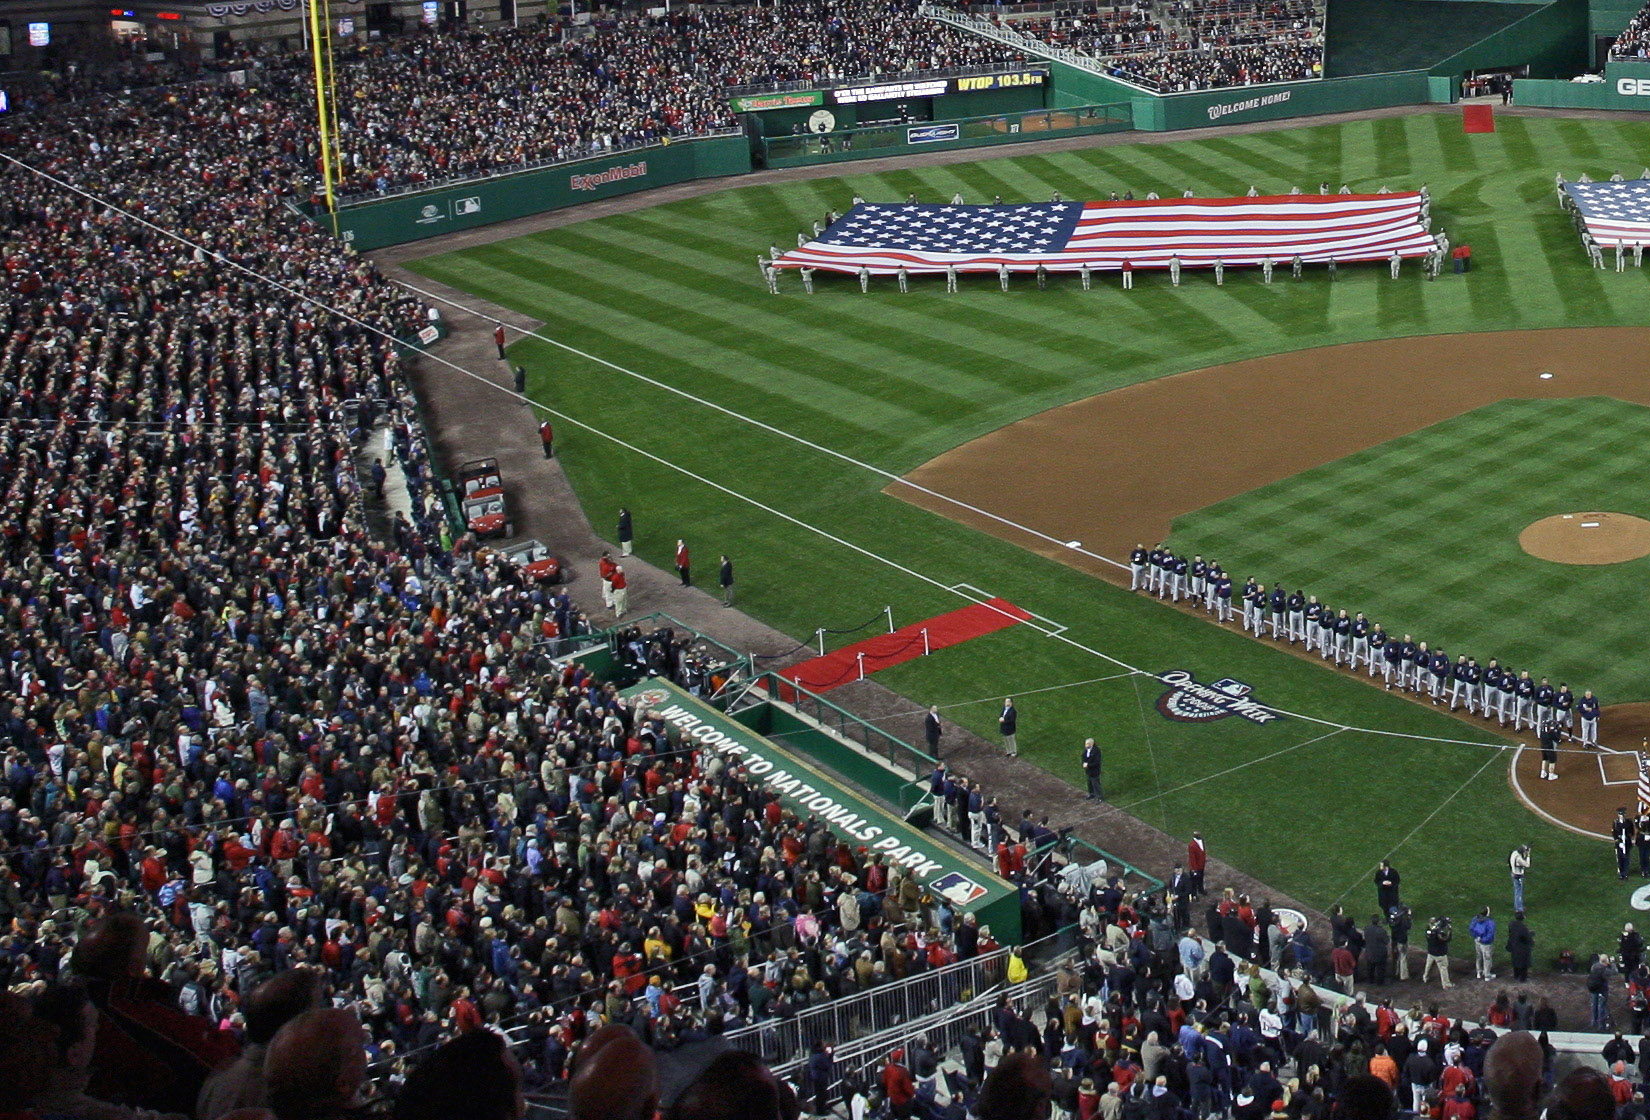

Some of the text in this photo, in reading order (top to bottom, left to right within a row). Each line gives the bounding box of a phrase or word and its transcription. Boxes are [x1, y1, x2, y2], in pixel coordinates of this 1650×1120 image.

[957, 76, 994, 91] WTOP
[1207, 90, 1291, 120] WELCOME HOME!
[570, 161, 648, 191] ExxonMobil
[1160, 670, 1227, 704] OPENING
[1226, 695, 1277, 723] WEEK
[660, 704, 943, 877] WELCOME TO NATIONALS PARK
